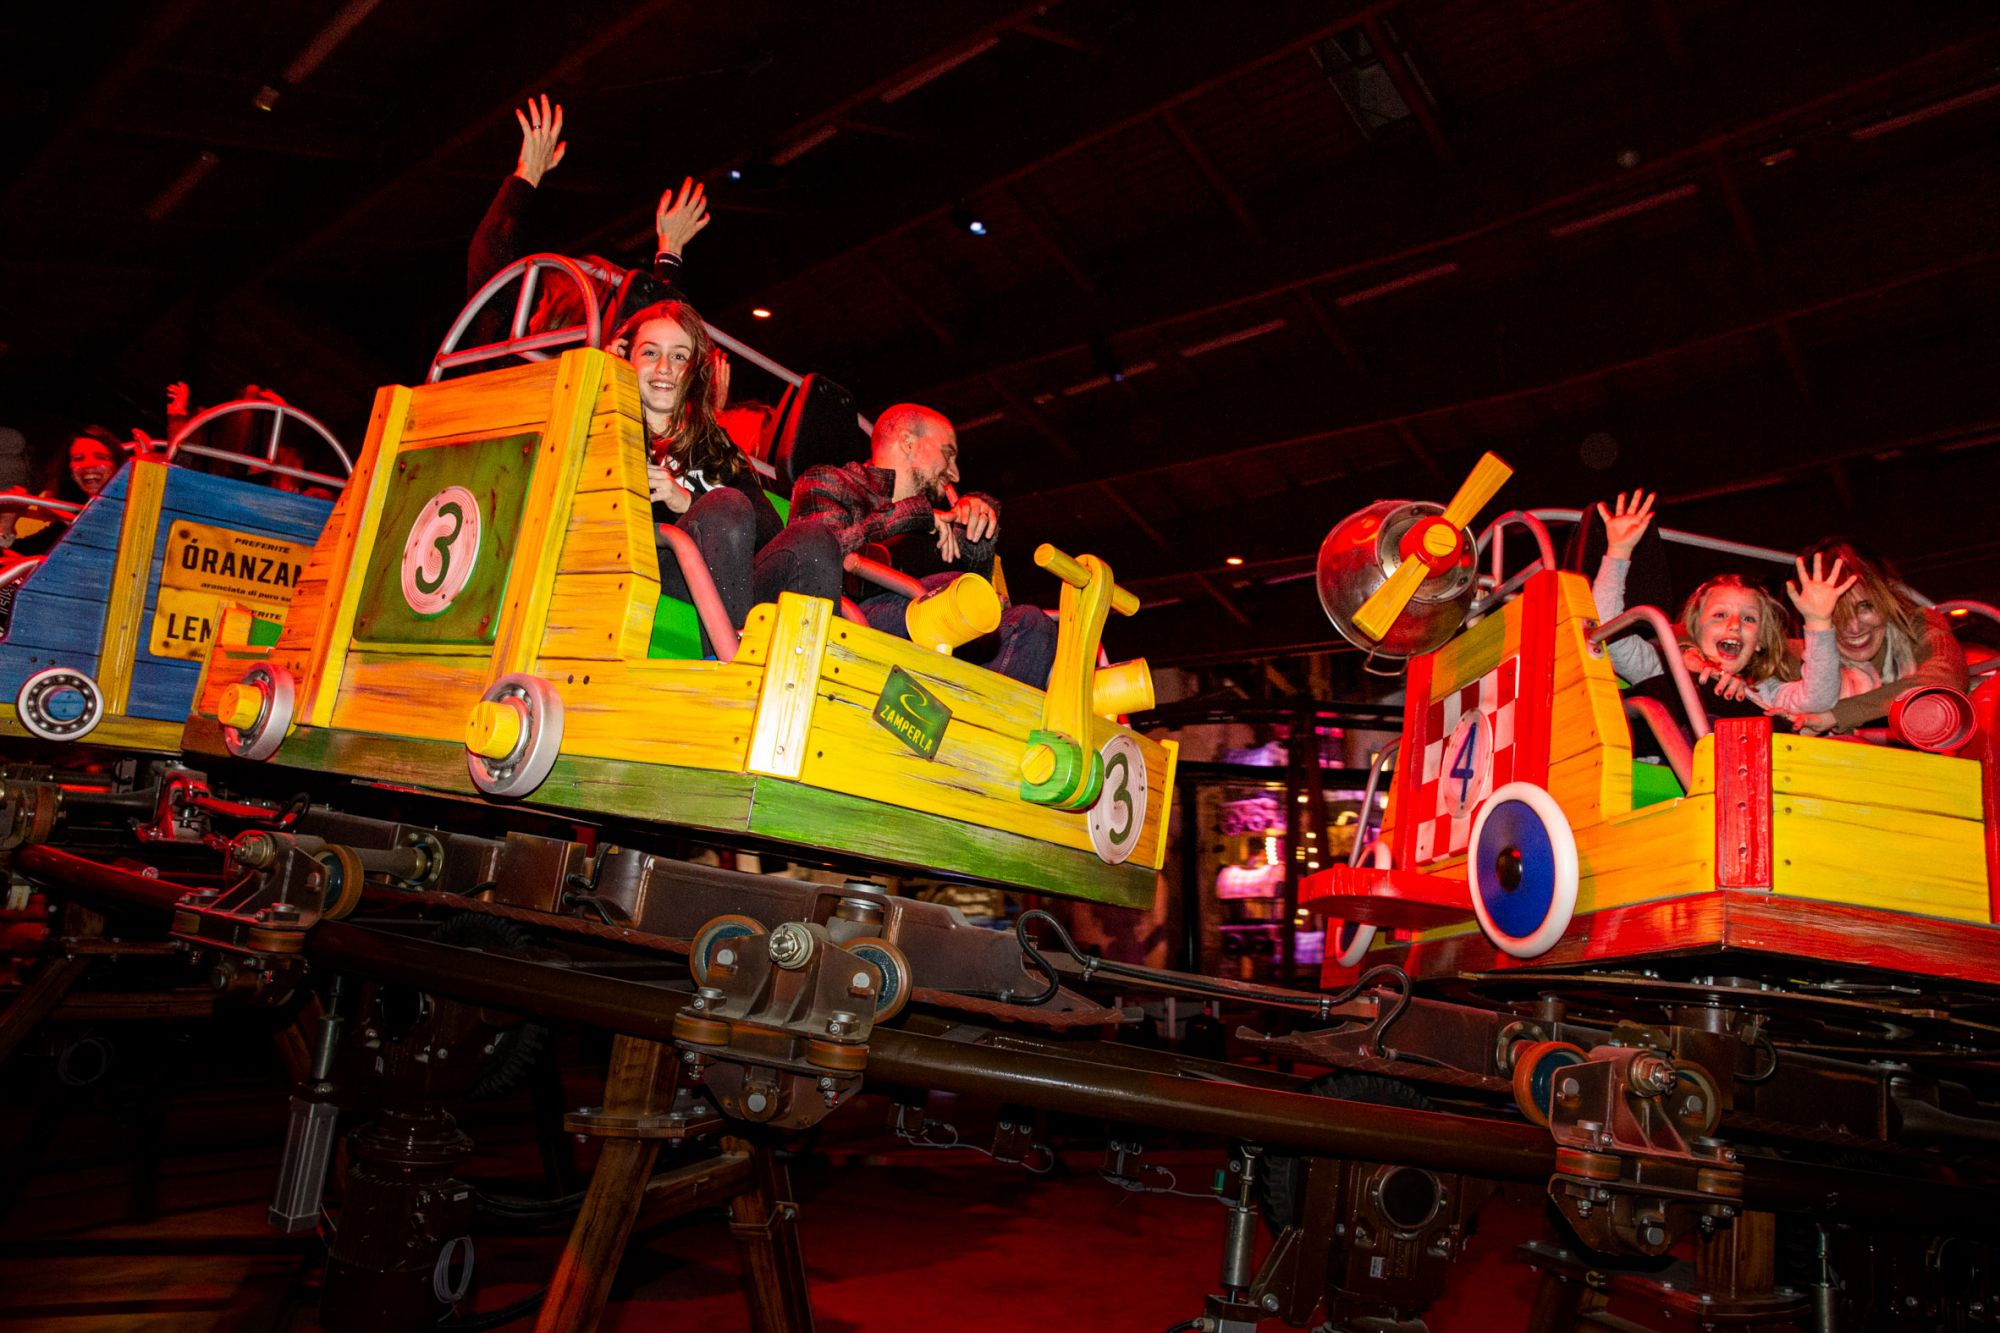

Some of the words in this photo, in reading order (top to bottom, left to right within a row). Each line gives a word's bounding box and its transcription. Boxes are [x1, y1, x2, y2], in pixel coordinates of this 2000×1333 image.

[235, 537, 290, 553] PREFERITE
[415, 501, 463, 594] 3
[879, 704, 933, 753] ZAMPERLA
[1450, 722, 1477, 803] 4
[1105, 752, 1133, 845] 3
